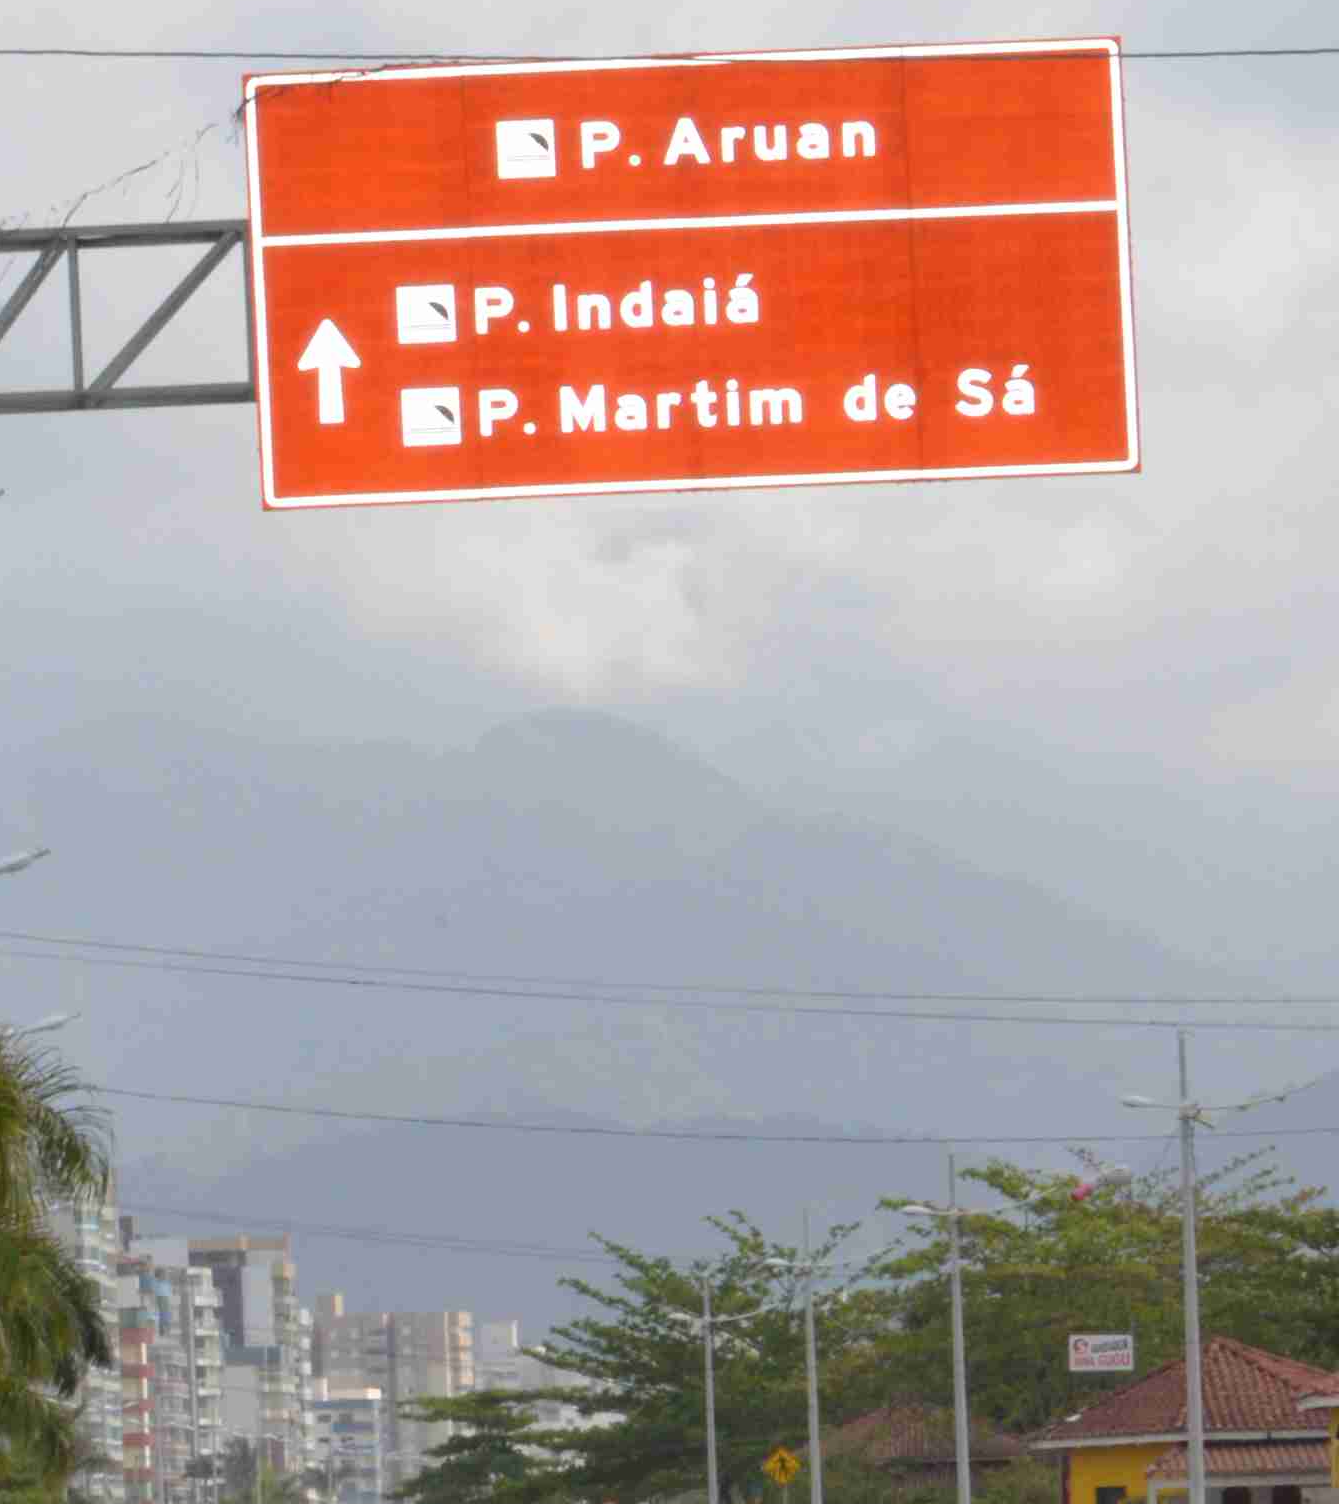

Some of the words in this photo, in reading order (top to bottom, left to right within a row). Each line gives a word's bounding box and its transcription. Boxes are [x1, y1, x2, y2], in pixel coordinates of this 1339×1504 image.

[580, 120, 642, 169] P.
[663, 117, 878, 168] Aruan
[474, 286, 531, 335] P.
[553, 273, 760, 332] Indaiá
[478, 388, 537, 437] P.
[559, 377, 803, 433] Martim
[843, 373, 919, 422] de
[955, 364, 1036, 417] Sá
